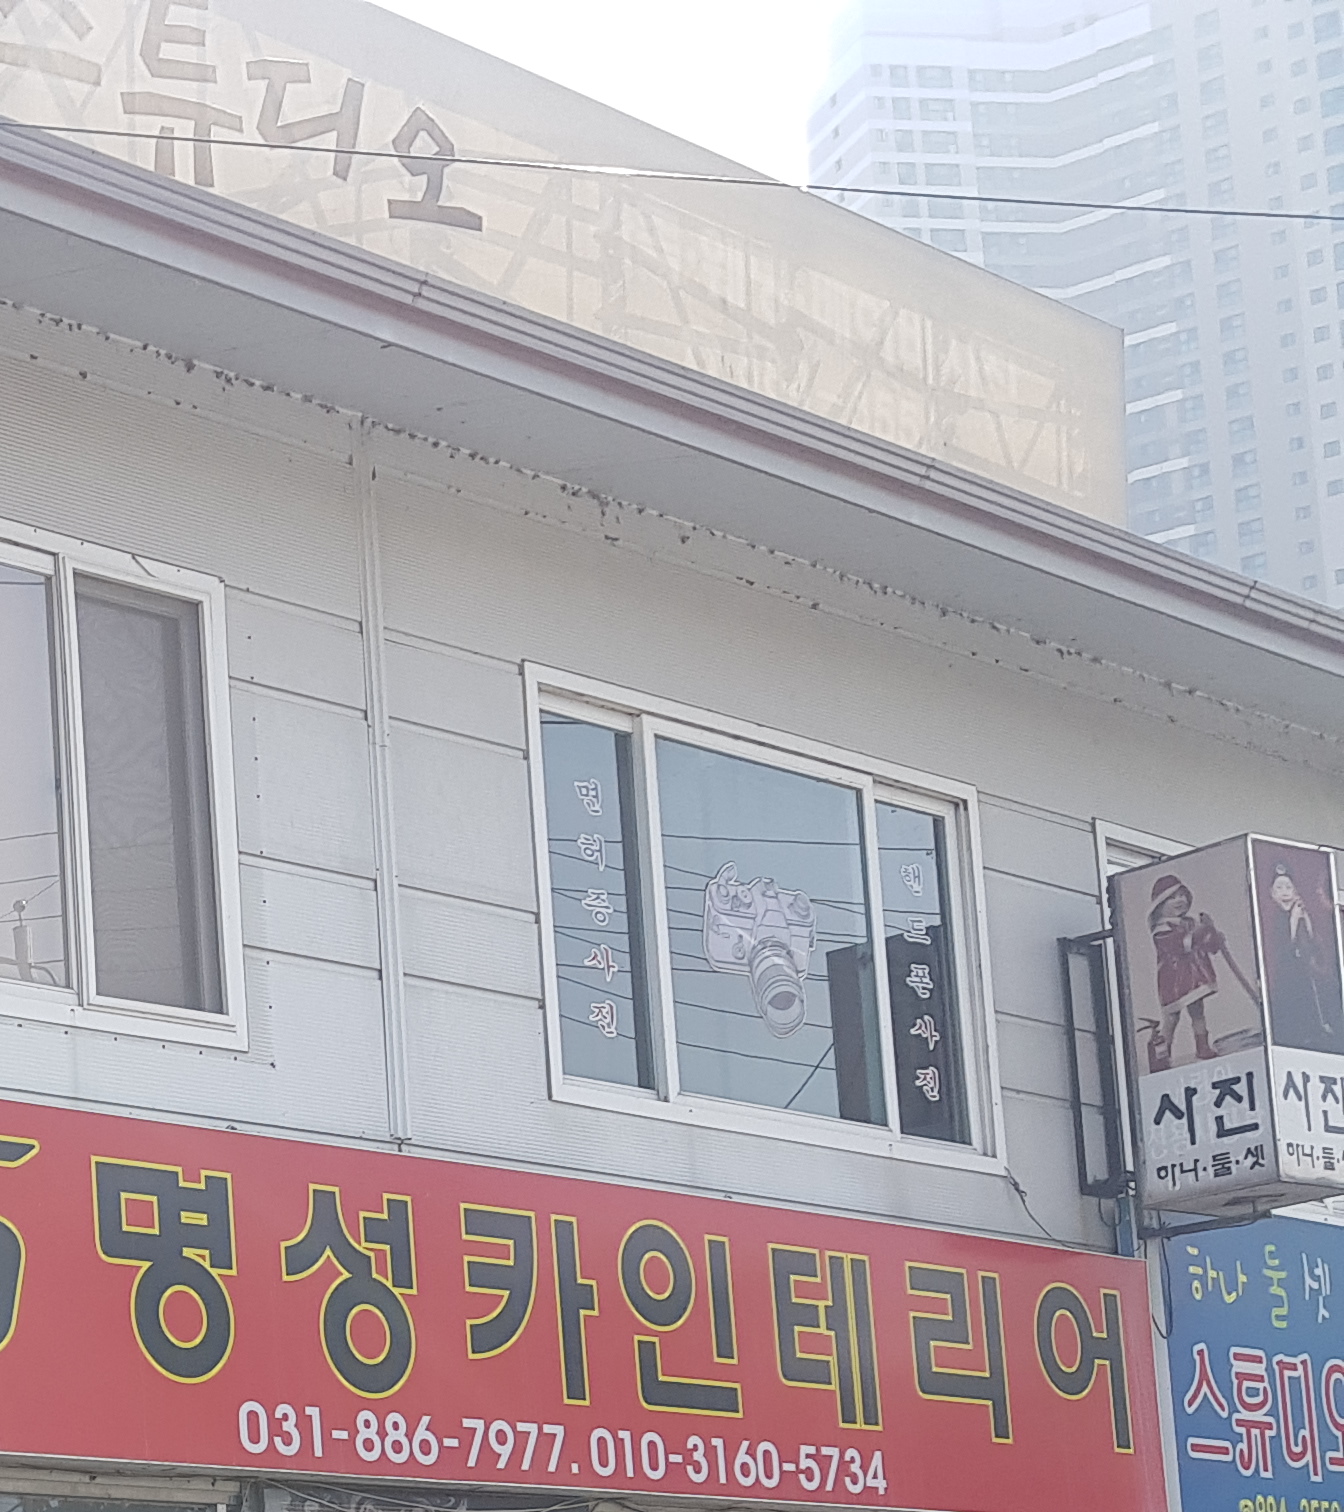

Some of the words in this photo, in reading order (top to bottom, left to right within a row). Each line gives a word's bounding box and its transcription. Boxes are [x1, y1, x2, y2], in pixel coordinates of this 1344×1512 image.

[1153, 1071, 1260, 1145] 사진
[91, 1155, 1136, 1455] 명성카인테리어
[590, 1427, 888, 1496] 010-3160-5734
